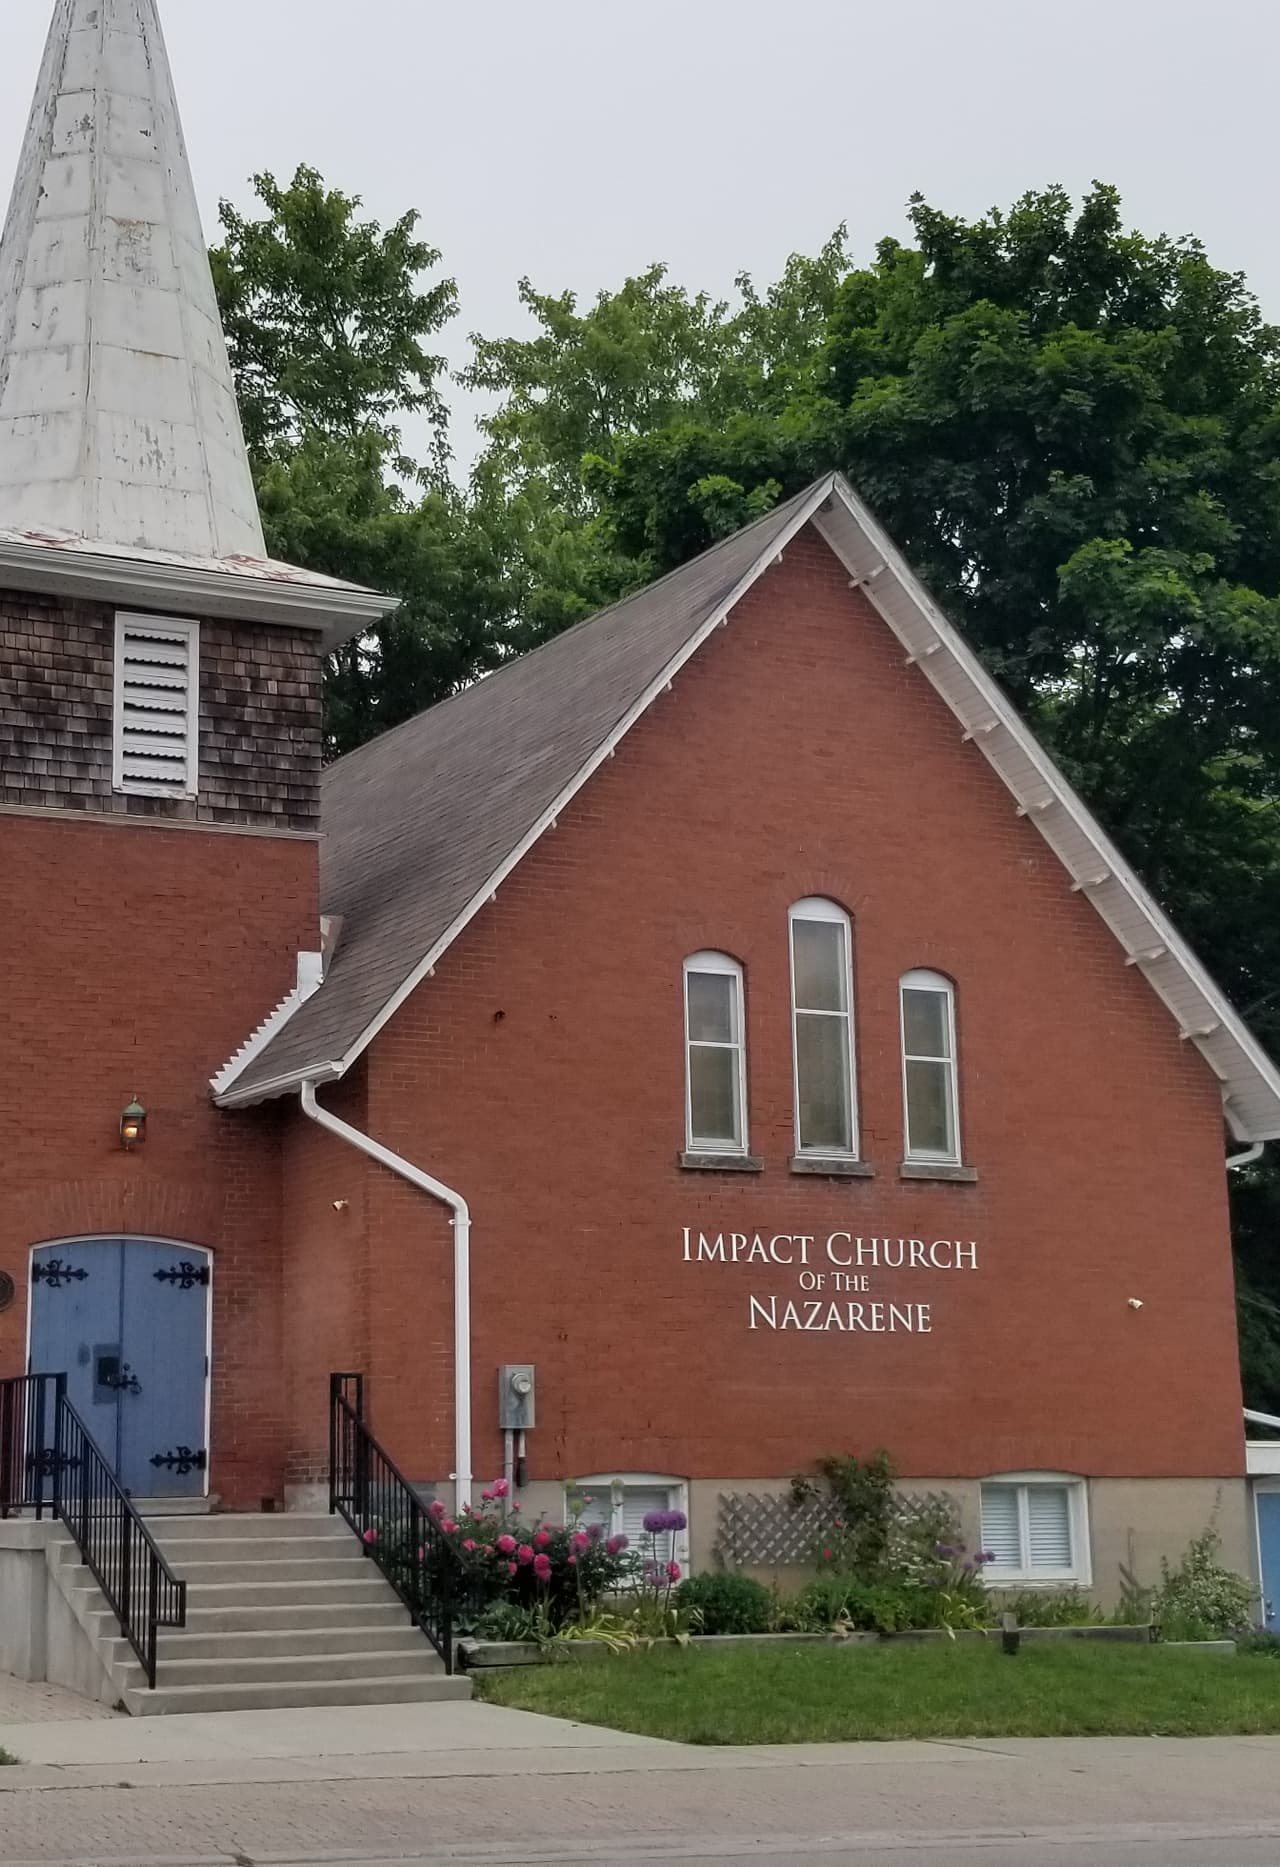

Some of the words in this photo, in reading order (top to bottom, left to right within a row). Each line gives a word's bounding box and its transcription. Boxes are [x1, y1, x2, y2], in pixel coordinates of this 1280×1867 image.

[681, 1227, 814, 1264] IMPACT
[826, 1232, 979, 1269] CHURCH
[748, 1295, 933, 1333] NAZARENE
